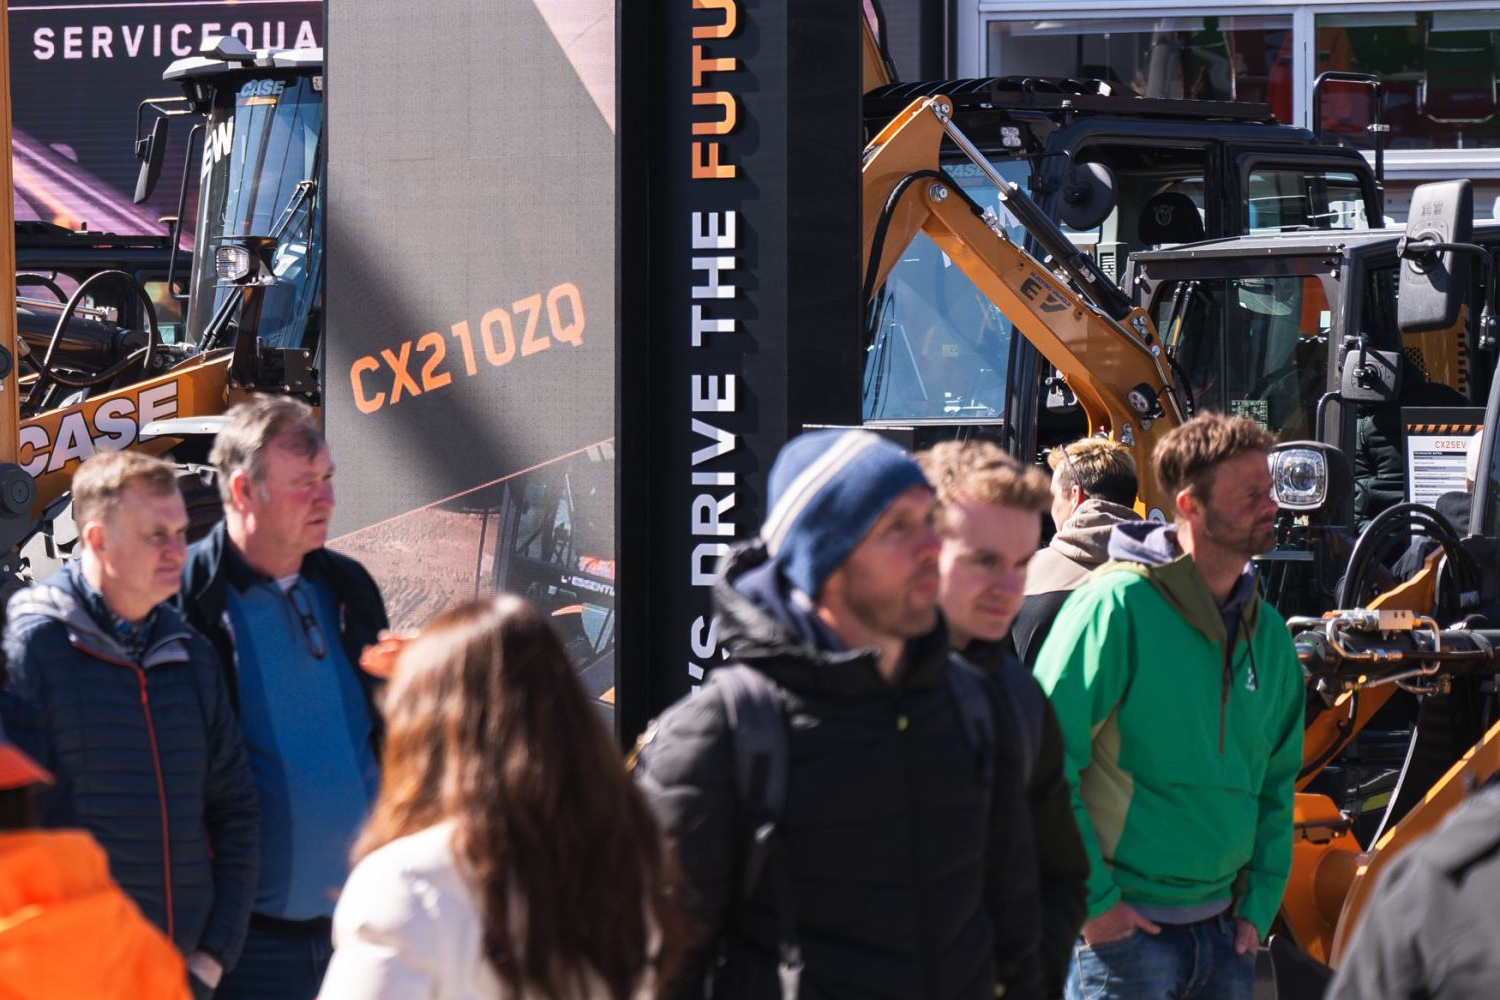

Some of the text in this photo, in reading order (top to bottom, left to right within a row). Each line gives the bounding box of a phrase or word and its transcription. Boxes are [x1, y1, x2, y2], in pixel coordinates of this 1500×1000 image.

[240, 79, 286, 97] CASE
[691, 211, 736, 348] THE
[1020, 277, 1068, 313] EV
[350, 282, 586, 415] CX210ZQ
[19, 379, 179, 479] CASE
[1434, 440, 1467, 449] CX25EV
[691, 373, 736, 586] DRIVE
